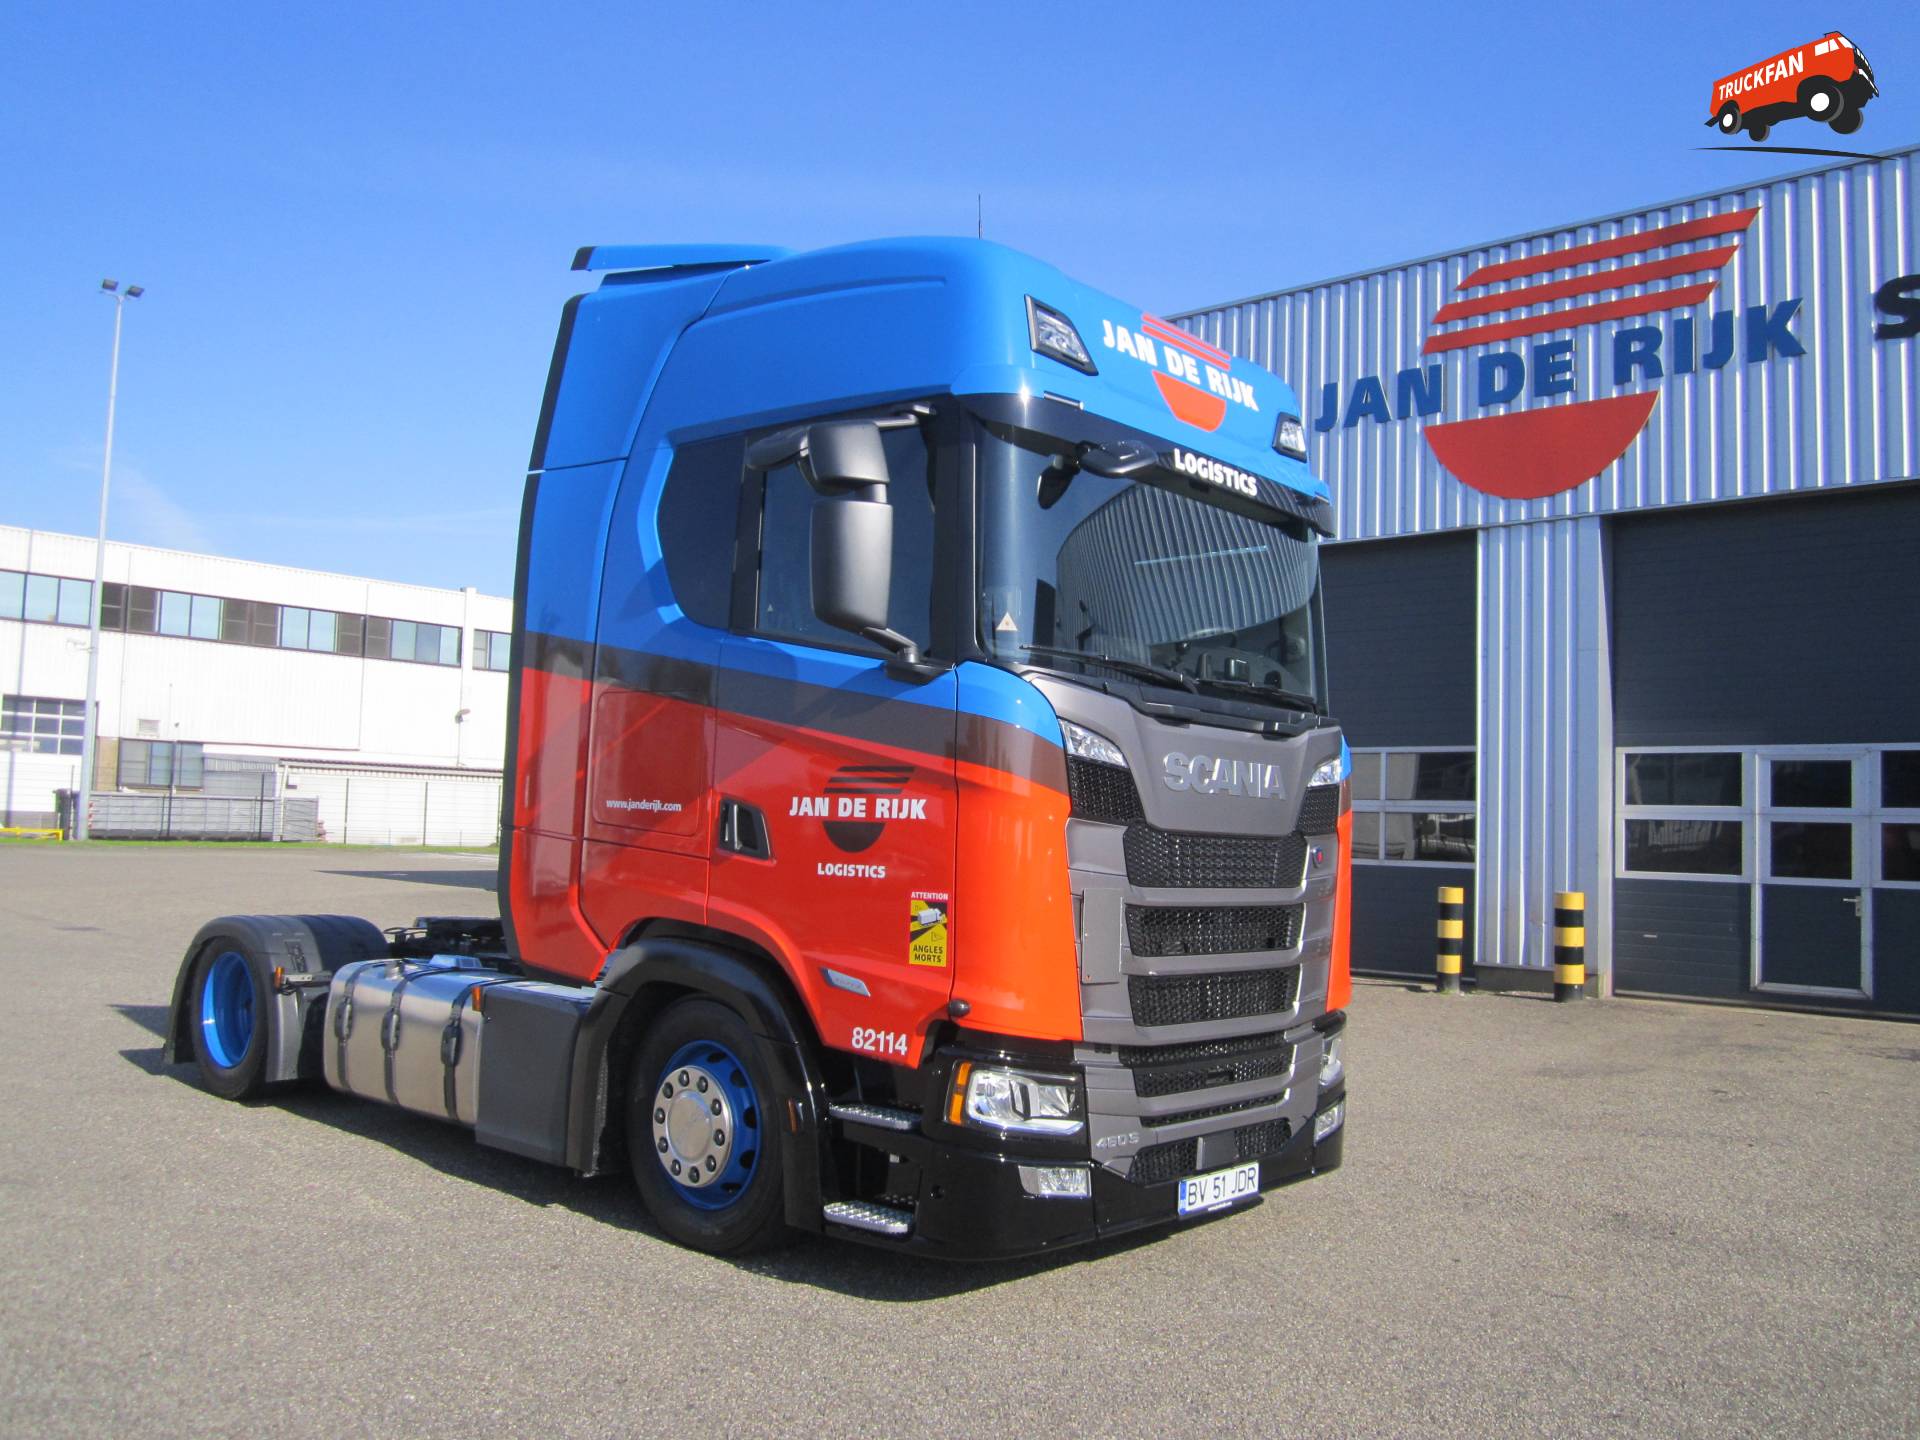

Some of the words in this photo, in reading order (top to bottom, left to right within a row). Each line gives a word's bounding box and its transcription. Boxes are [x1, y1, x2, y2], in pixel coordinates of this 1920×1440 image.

[1102, 319, 1159, 367] JAN
[1163, 346, 1201, 385] DE
[1205, 364, 1260, 412] RIJK
[1315, 364, 1443, 432] JAN
[1478, 339, 1575, 407] DE
[1614, 298, 1807, 385] RIJK
[1174, 448, 1258, 496] LOGISTICS
[1163, 751, 1286, 800] SCANIA
[606, 798, 682, 813] www.janderijk.com
[789, 796, 829, 817] JAN
[837, 797, 867, 818] DE
[875, 798, 927, 819] RIJK
[817, 862, 886, 878] LOGISTICS
[911, 891, 949, 900] ATTENTION
[913, 944, 943, 954] ANGLES
[914, 953, 942, 963] MORTS
[851, 1026, 908, 1056] 82114
[1188, 1179, 1208, 1206] BV
[1213, 1175, 1226, 1199] 51
[1232, 1167, 1257, 1194] JDR
